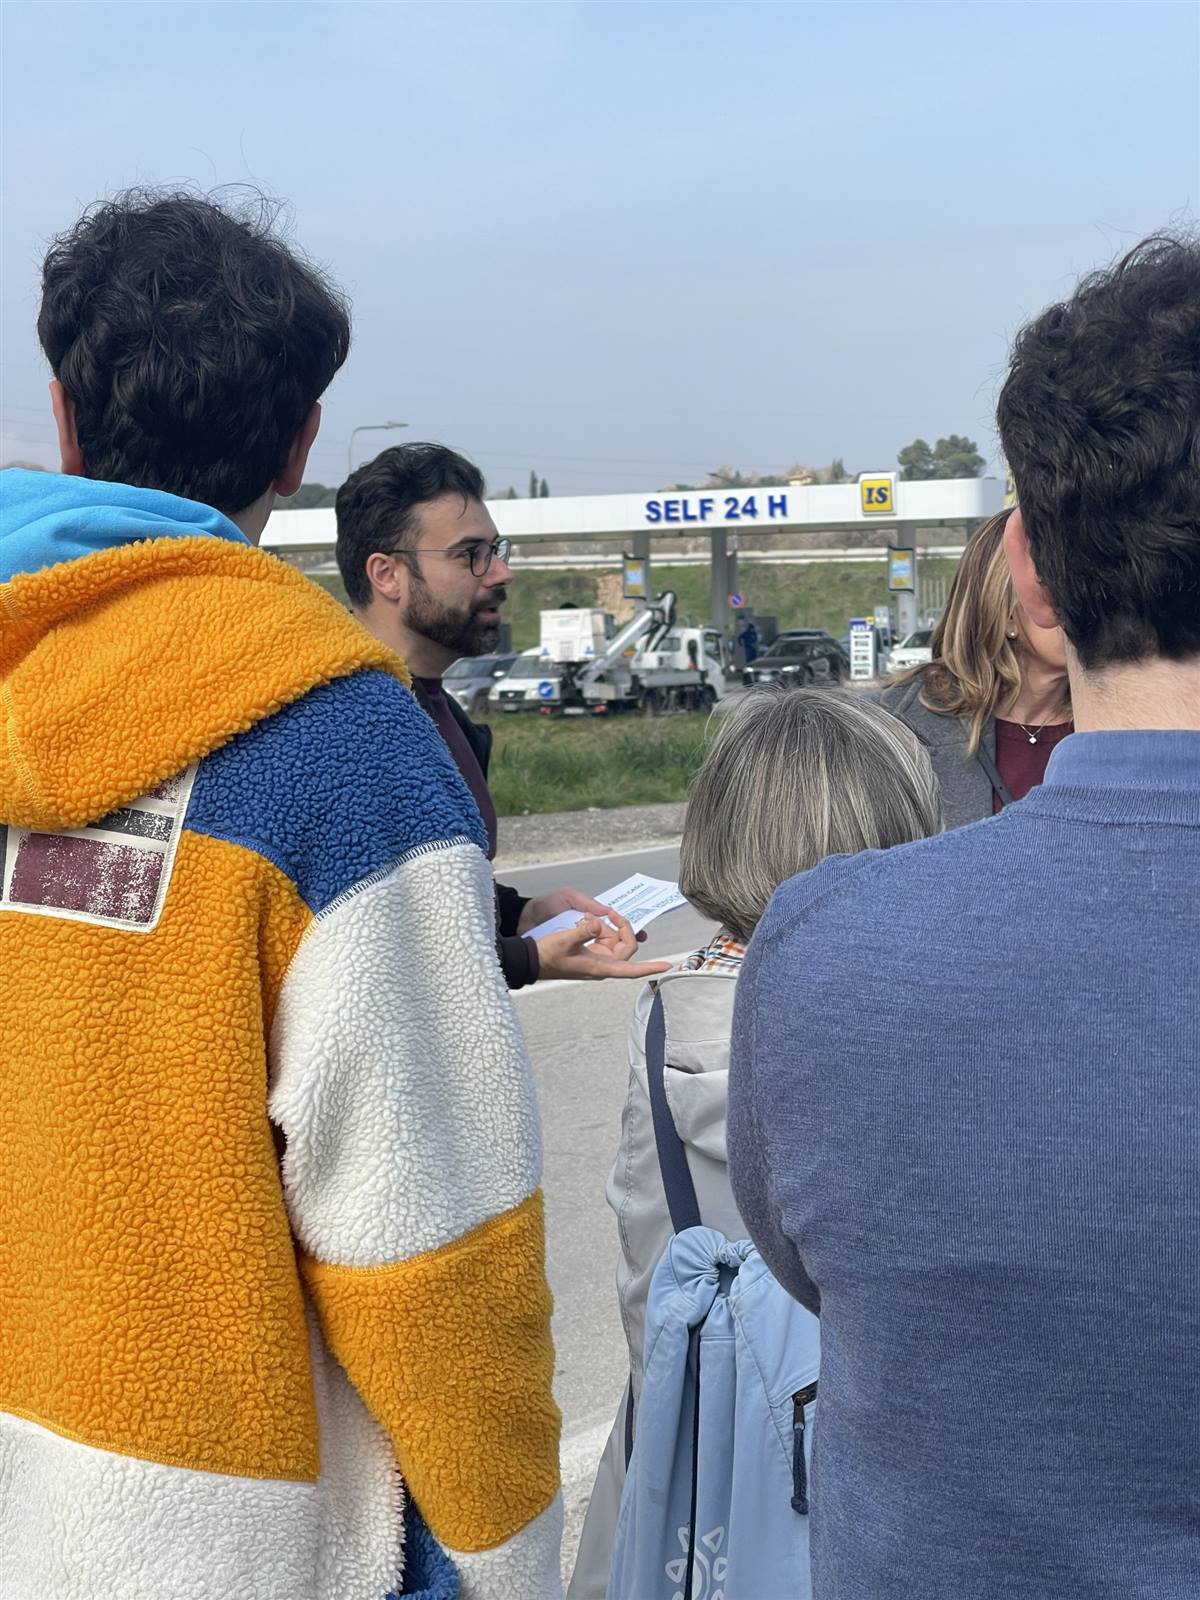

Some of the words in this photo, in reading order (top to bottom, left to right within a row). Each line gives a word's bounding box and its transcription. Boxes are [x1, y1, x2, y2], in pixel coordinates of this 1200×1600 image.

[865, 486, 889, 505] IS
[645, 498, 715, 523] SELF
[723, 496, 758, 520] 24
[767, 494, 788, 518] H
